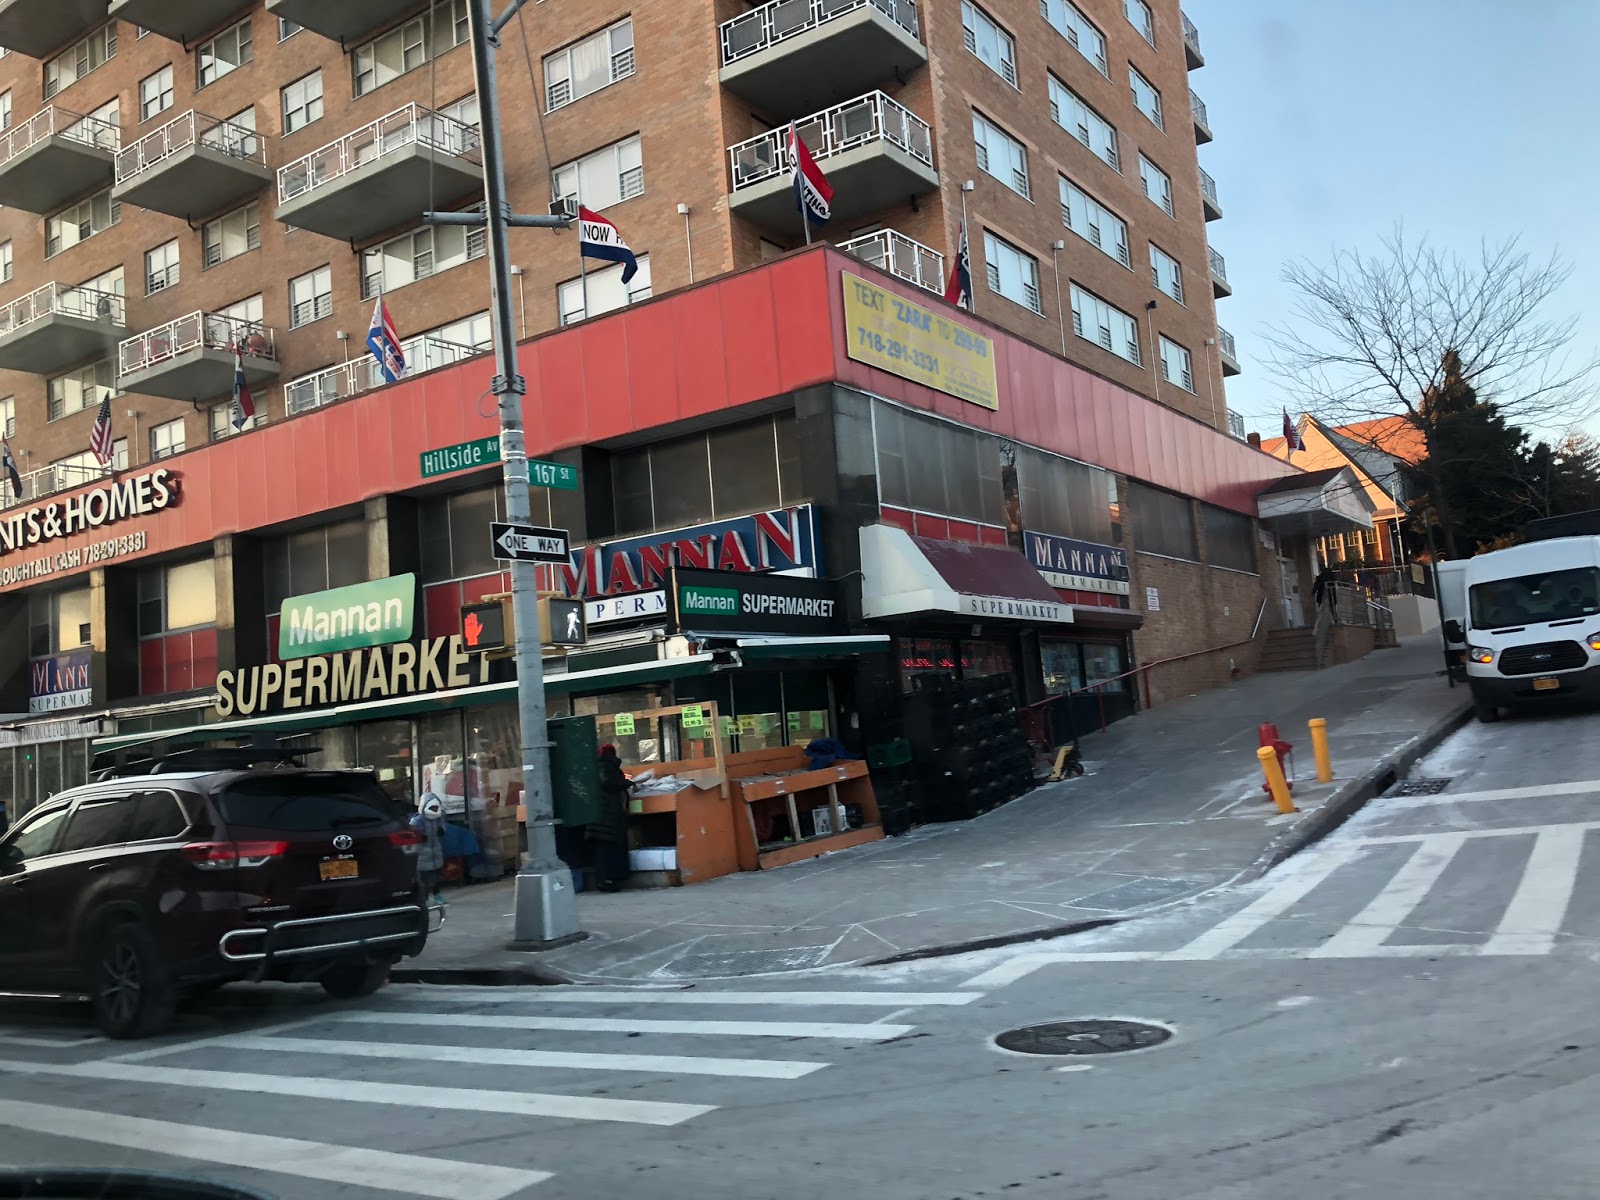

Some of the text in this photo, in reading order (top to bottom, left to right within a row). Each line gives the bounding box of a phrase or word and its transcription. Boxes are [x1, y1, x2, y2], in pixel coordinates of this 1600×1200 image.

[583, 223, 610, 242] NOW
[853, 280, 885, 313] TEXT
[857, 325, 940, 375] 718-291-3331
[424, 440, 498, 473] Hillside Av
[534, 463, 570, 485] 167 St
[65, 468, 170, 533] HOMES
[35, 555, 54, 577] ALL
[55, 549, 81, 572] CASH
[83, 530, 148, 566] 718-291-3331
[505, 535, 560, 554] ONE WAY
[553, 507, 801, 600] MANNAN
[1034, 536, 1122, 575] MANNAN
[1042, 572, 1128, 593] UPERMARKET
[685, 590, 835, 618] Mannan SUPERMARKET
[971, 599, 1059, 620] SUPERMARKET
[288, 597, 403, 647] Mannan
